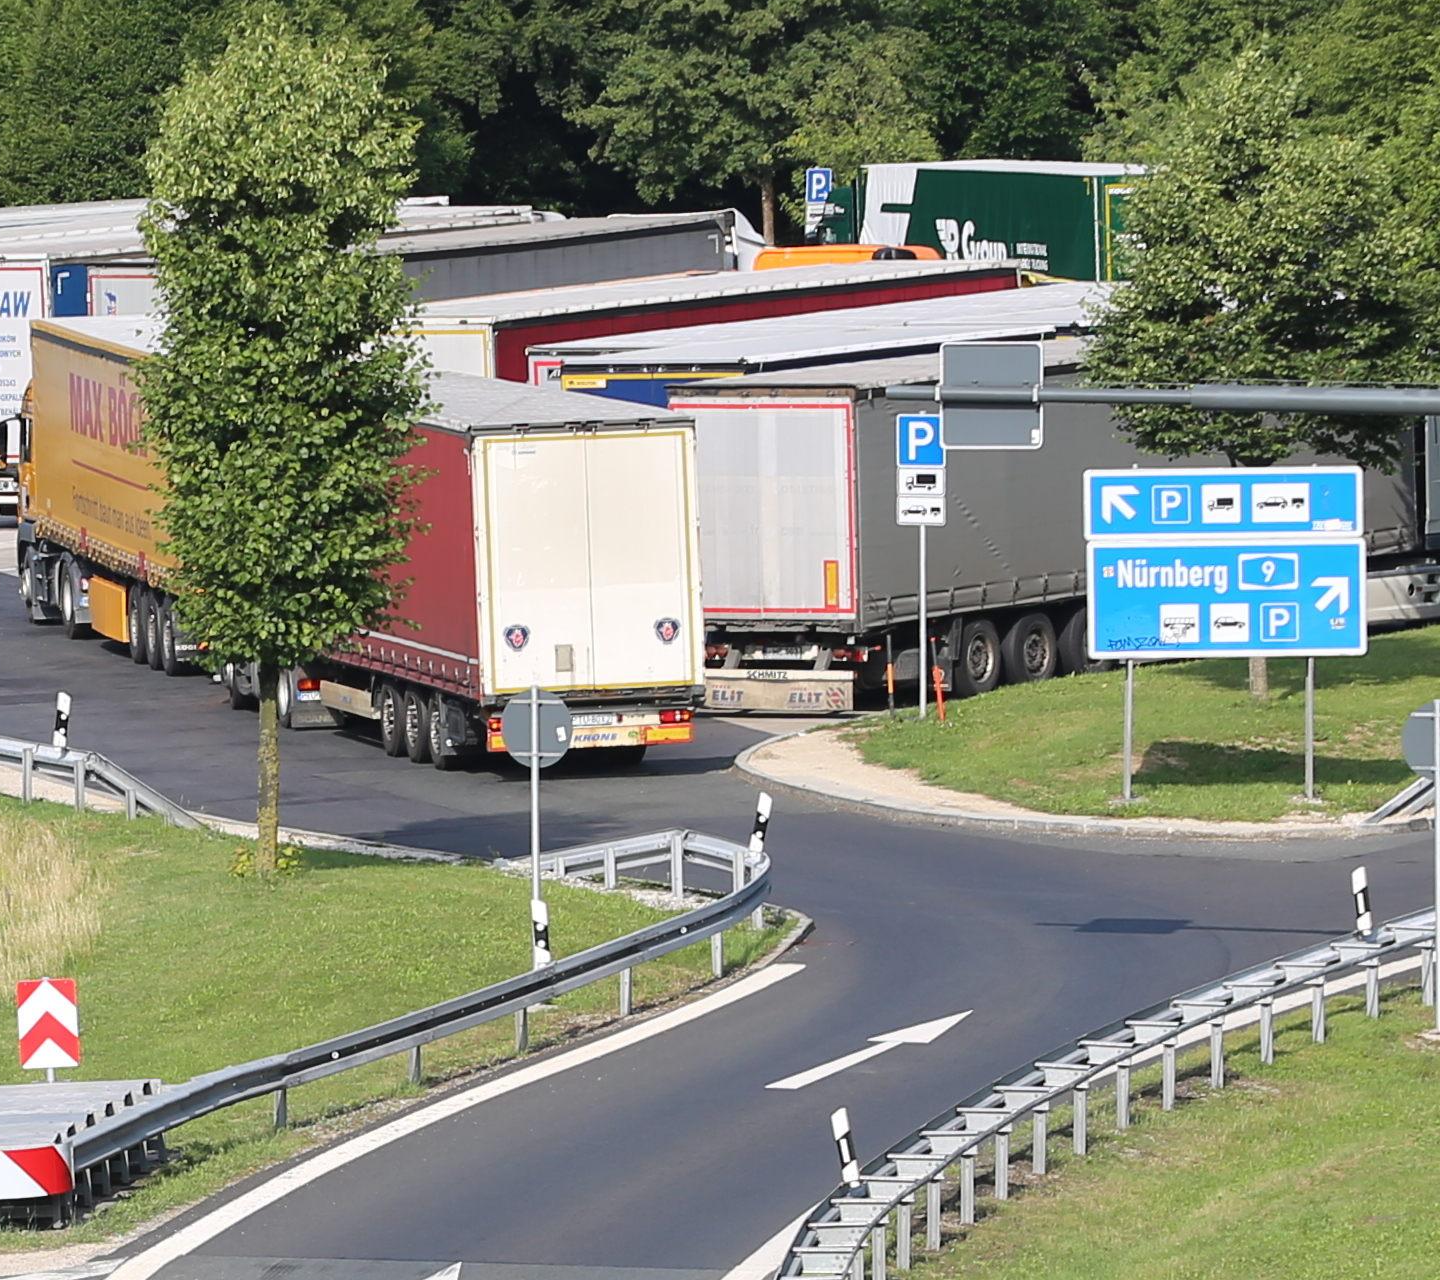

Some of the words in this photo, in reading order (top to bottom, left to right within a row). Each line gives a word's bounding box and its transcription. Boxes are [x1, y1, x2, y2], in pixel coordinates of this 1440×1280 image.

[69, 372, 104, 443] MAX
[908, 421, 934, 461] P
[1160, 490, 1182, 519] P
[1117, 559, 1229, 594] Nürnberg
[1261, 561, 1275, 583] 9
[1269, 607, 1290, 637] P
[746, 670, 788, 680] SCHMITZ
[574, 732, 618, 742] KRONE
